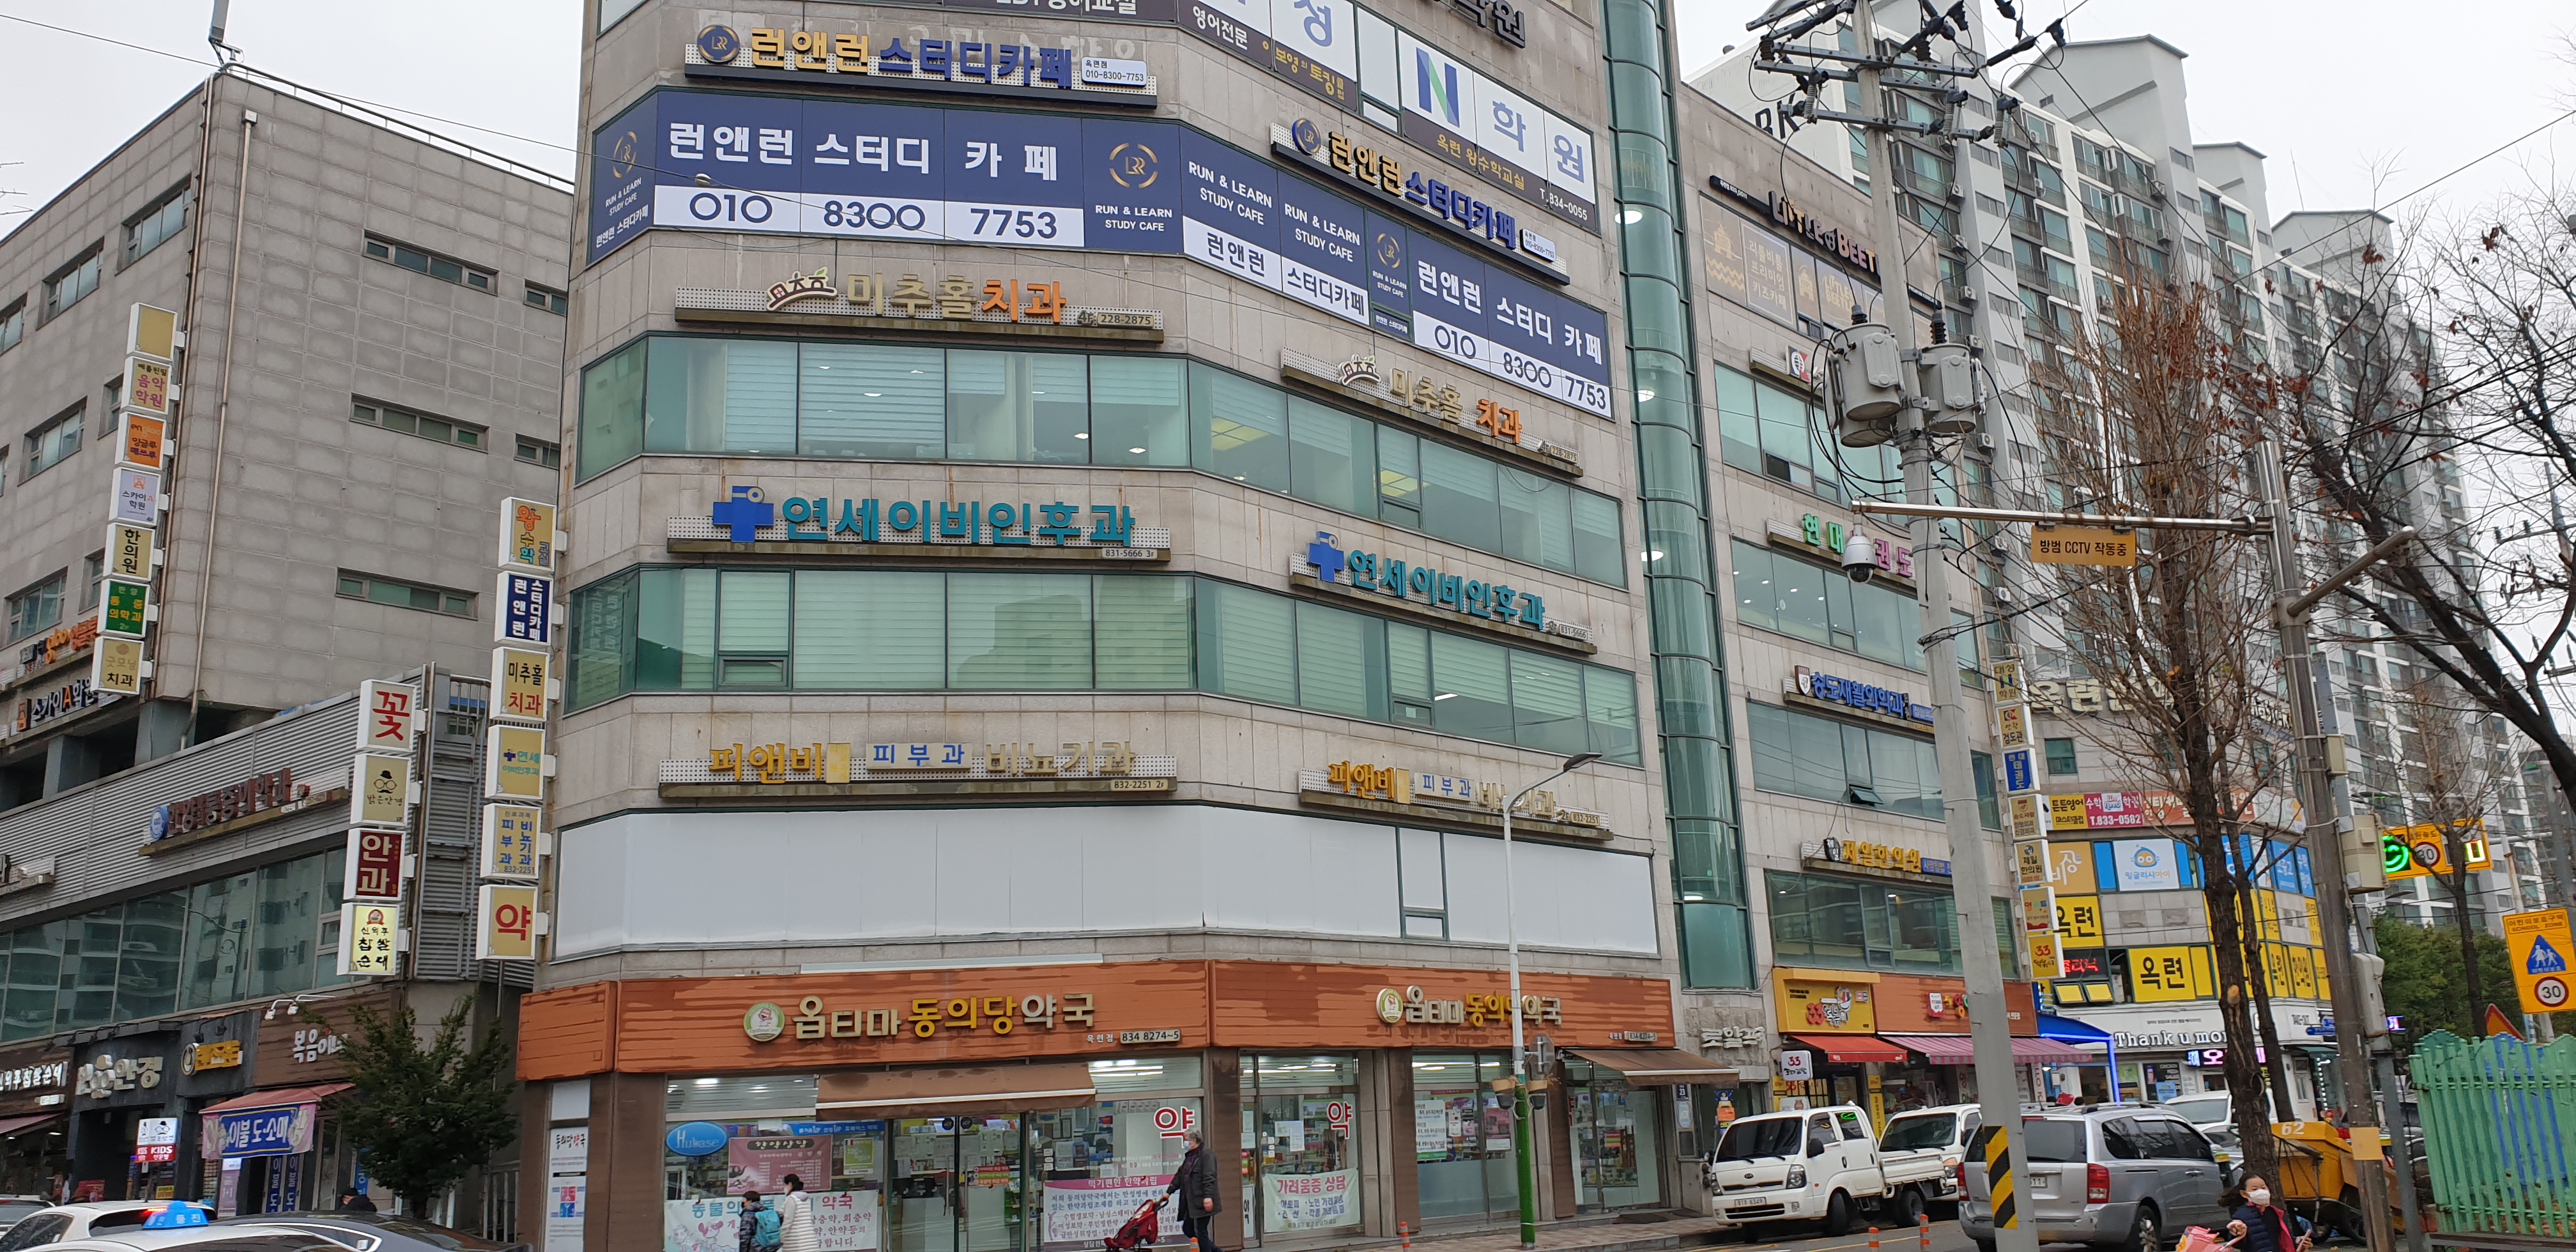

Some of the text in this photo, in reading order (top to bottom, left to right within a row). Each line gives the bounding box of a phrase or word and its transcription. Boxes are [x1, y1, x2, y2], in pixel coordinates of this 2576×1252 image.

[1192, 6, 1248, 50] 영어전문
[751, 26, 1074, 89] 런앤런 스터디카페
[1085, 70, 1144, 82] 010-8300-7753
[1416, 47, 1460, 128] N
[670, 123, 793, 165] 런앤런
[815, 132, 930, 174] 스터디
[1436, 134, 1525, 190] 옥련 왕수학교실
[1188, 161, 1273, 208] RUN & LEARN
[1328, 132, 1517, 250] 런앤런 스터디카페
[690, 192, 1057, 240] 010 8300 7753
[1095, 204, 1173, 218] RUN & LEARN
[1105, 220, 1165, 232] STUDY CAFE
[1200, 187, 1264, 226] STUDY CAFE
[1284, 203, 1361, 246] RUN & LEARN
[1207, 232, 1265, 278] 런앤런
[1295, 228, 1353, 263] STUDY CAFE
[1836, 227, 1880, 277] BEET
[1287, 267, 1365, 316] 스터디카페
[1417, 259, 1482, 315] 런앤런
[1496, 296, 1552, 345] 스터디
[1101, 314, 1151, 325] 228-2875
[137, 374, 165, 392] 음악
[1434, 324, 1607, 411] 010 8300 7753
[135, 390, 163, 408] 학원
[1390, 368, 1523, 445] 미추홀 치과
[781, 495, 1136, 548] 연세이비인후과
[121, 529, 141, 574] 한의원
[1105, 548, 1144, 559] 831-5666
[2040, 540, 2127, 557] 방범 CCTV 작동중
[1347, 549, 1545, 631] 연세이비인후과
[512, 579, 544, 641] 런앤런 스터디카페
[107, 673, 134, 687] 치과
[509, 662, 543, 686] 미추홀
[372, 690, 410, 741] 꽃
[509, 692, 542, 715] 치과
[873, 740, 1137, 776] 피부과 비뇨기과
[1114, 781, 1153, 791] 832-2251
[1422, 774, 1471, 798] 피부과
[358, 835, 392, 894] 안과
[495, 904, 532, 941] 약
[356, 954, 389, 972] 순대
[2140, 956, 2185, 991] 옥련
[2542, 985, 2561, 999] 30
[1122, 1032, 1140, 1042] 834
[2114, 1030, 2174, 1048] Thank
[2178, 1033, 2192, 1045] u
[1153, 1106, 1196, 1150] 약
[1327, 1101, 1353, 1140] 약
[2281, 1122, 2306, 1136] 62
[1277, 1174, 1346, 1195] 가려움증 상담
